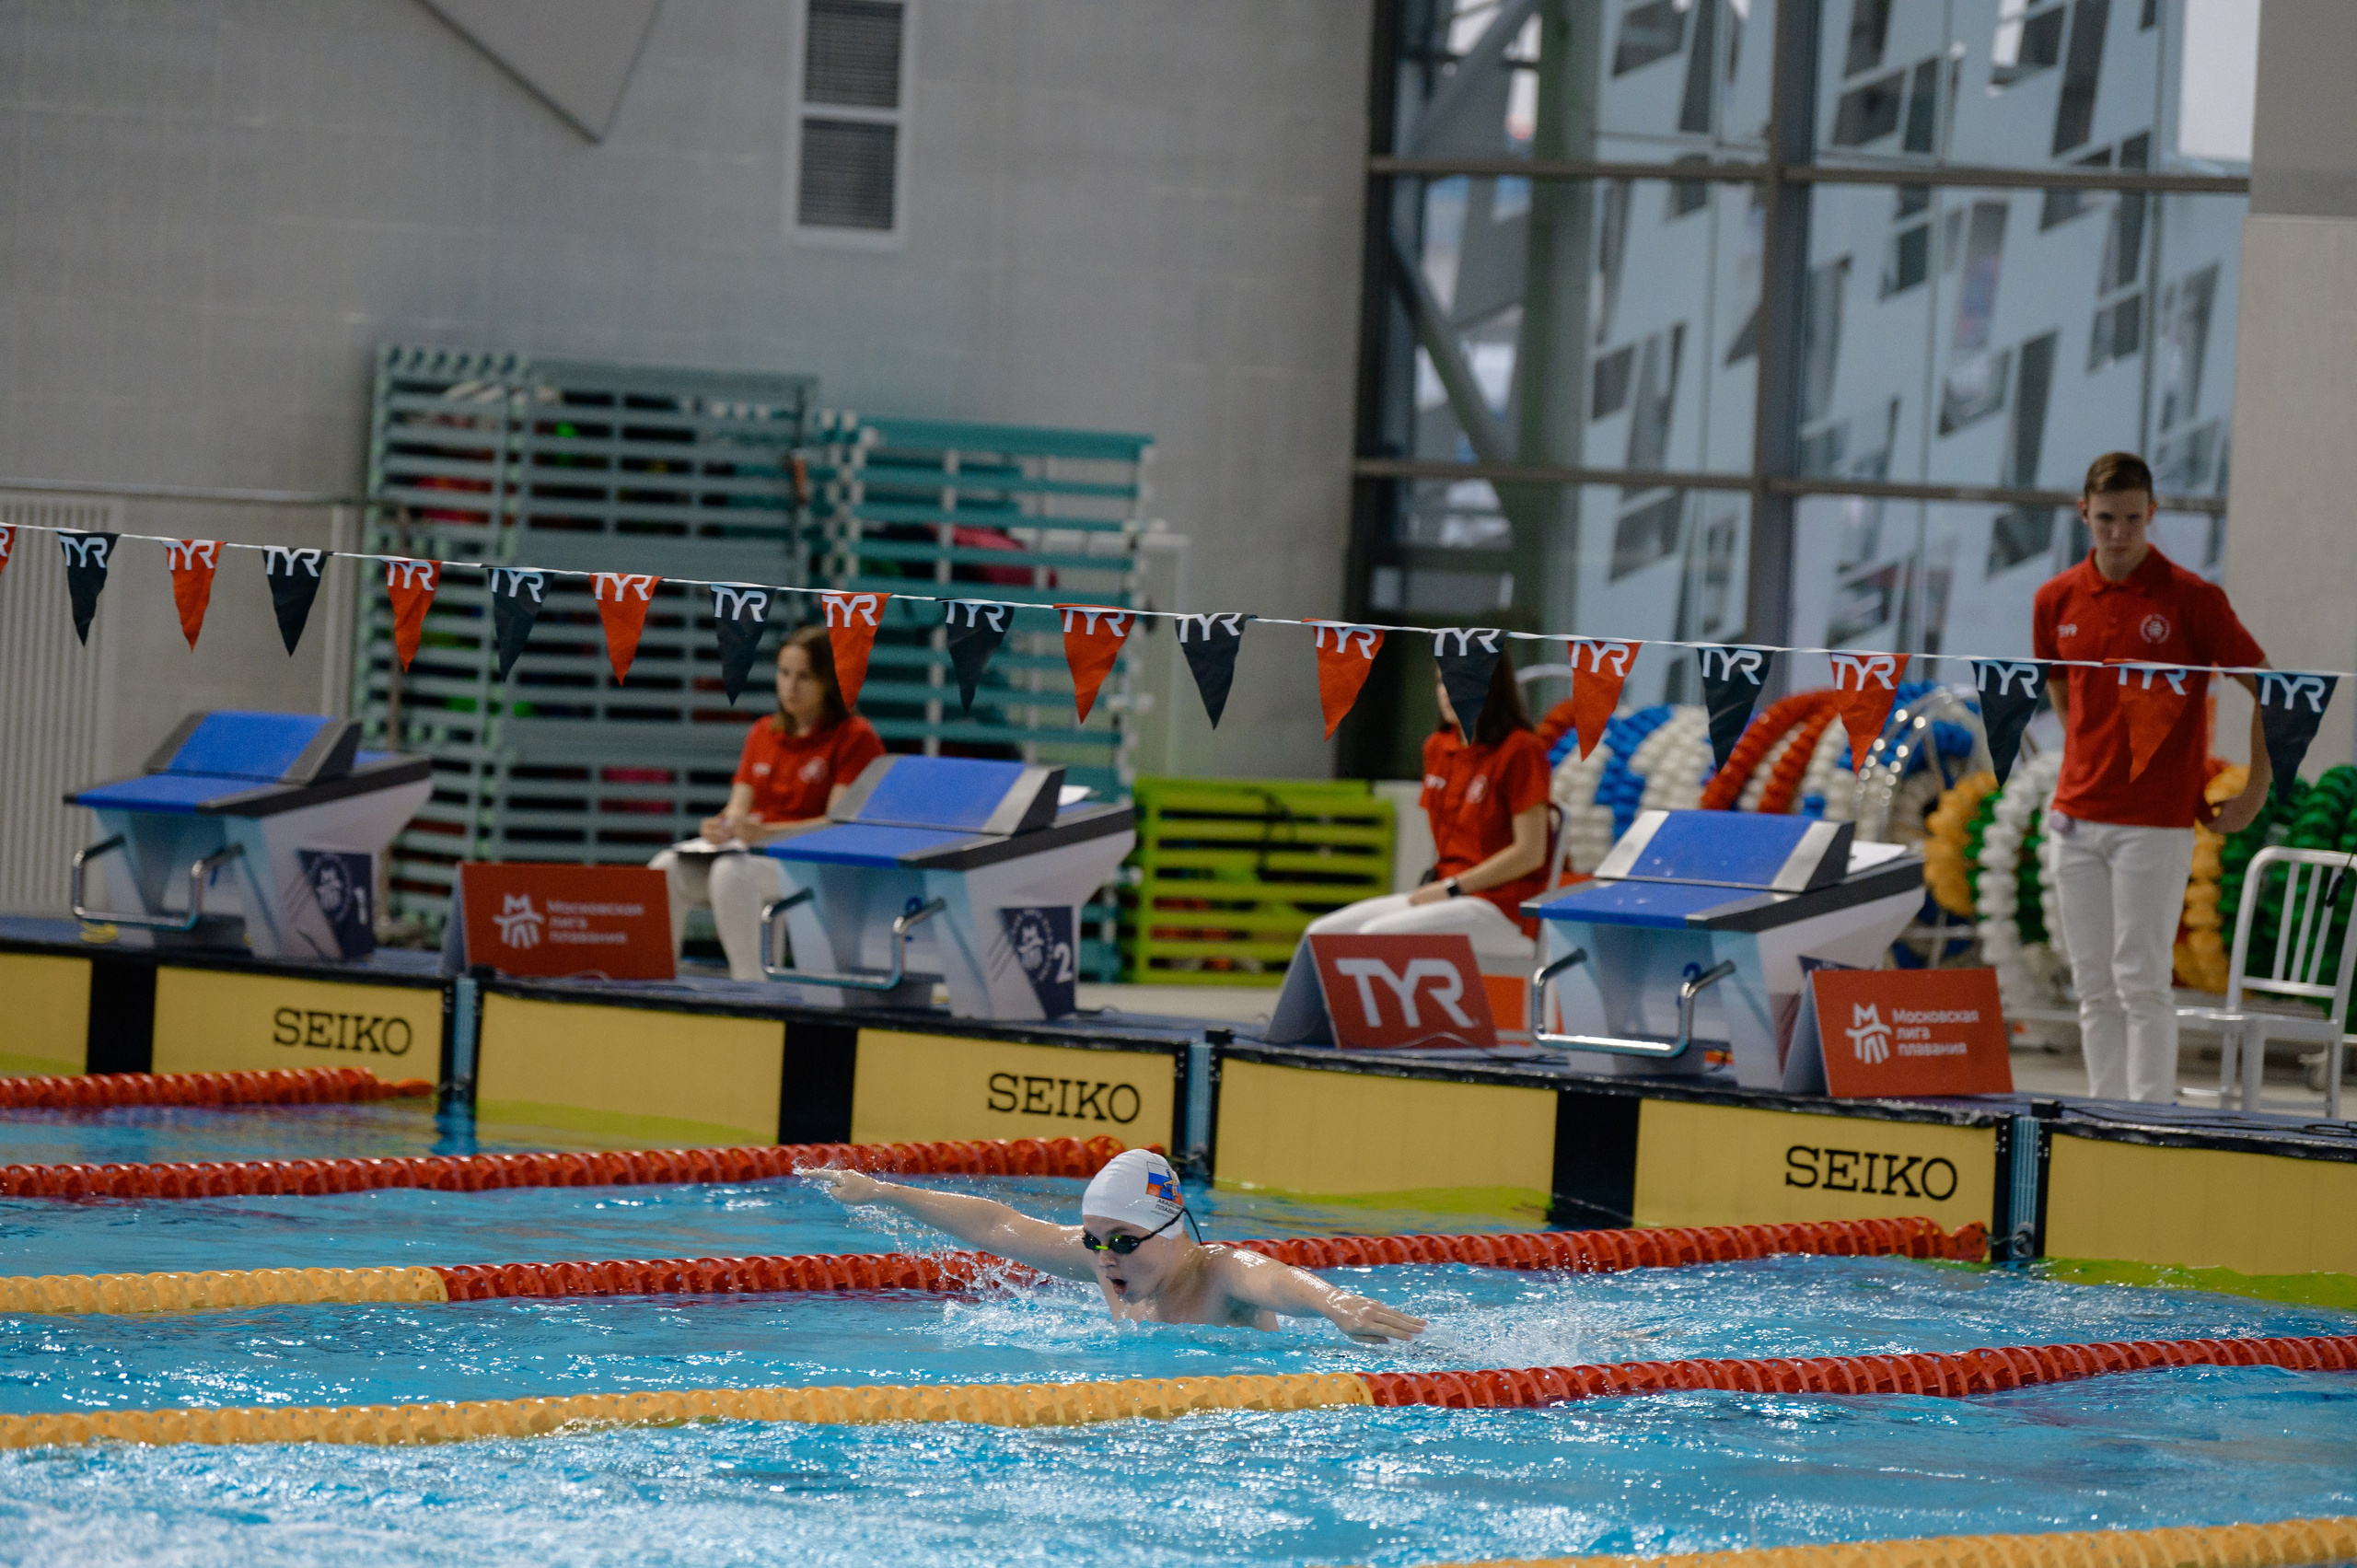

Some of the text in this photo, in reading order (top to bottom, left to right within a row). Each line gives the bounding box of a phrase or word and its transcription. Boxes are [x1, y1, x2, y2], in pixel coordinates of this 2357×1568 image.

[60, 535, 108, 569] TYR
[164, 540, 215, 570] TYR
[263, 546, 321, 577] TYR
[387, 561, 435, 591] TYR
[491, 568, 543, 603] TYR
[590, 574, 653, 602] TYR
[712, 585, 767, 622] TYR
[821, 594, 877, 628] TYR
[1177, 612, 1243, 643] TYR
[1433, 629, 1501, 656] TYR
[1571, 641, 1630, 677] TYR
[1700, 648, 1762, 685] TYR
[1831, 654, 1896, 691] TYR
[1976, 661, 2040, 698] TYR
[2259, 673, 2326, 713] TYR
[1054, 942, 1074, 983] 2
[1335, 958, 1476, 1028] TYR
[273, 1007, 412, 1055] SEIKO
[1892, 1008, 1980, 1024] Московская
[1896, 1027, 1931, 1040] лига
[1898, 1042, 1968, 1056] плавания
[988, 1073, 1141, 1124] SEIKO
[1785, 1145, 1957, 1202] SEIKO
